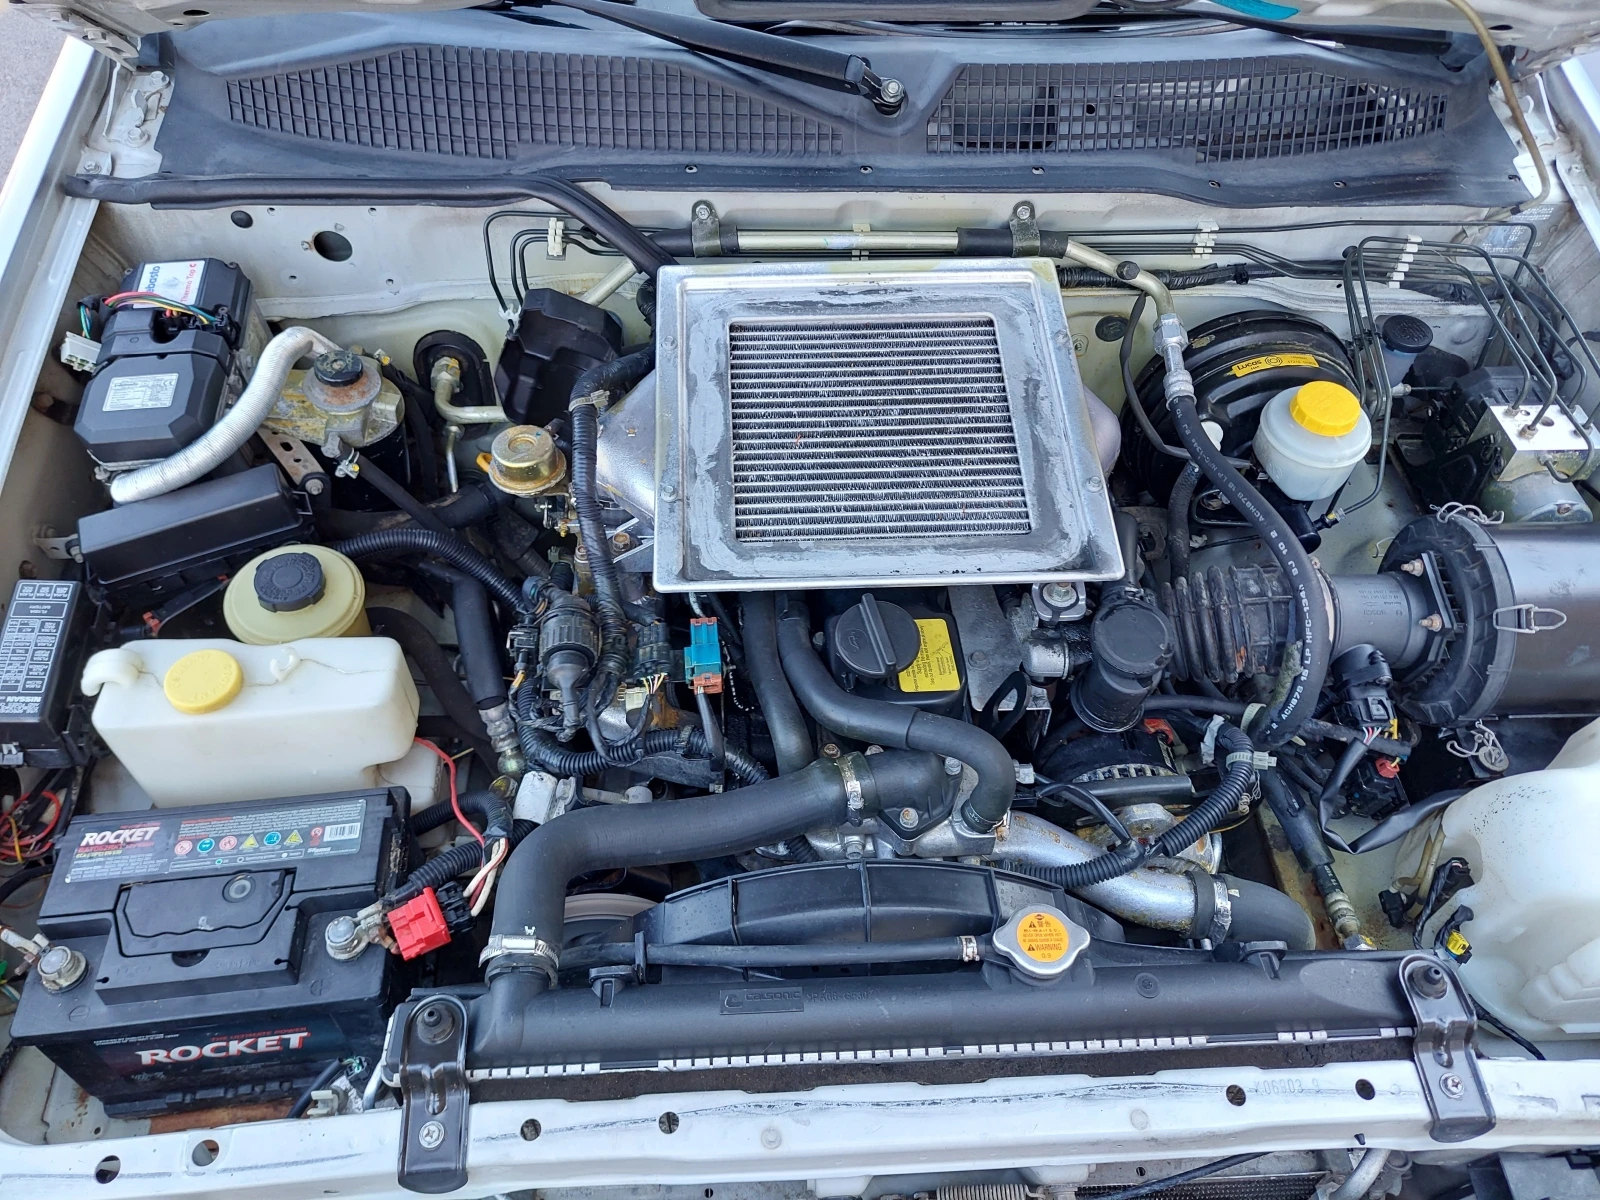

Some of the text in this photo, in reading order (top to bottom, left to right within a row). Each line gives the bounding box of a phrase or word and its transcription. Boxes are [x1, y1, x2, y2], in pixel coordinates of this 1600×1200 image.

[145, 266, 160, 292] ebasto
[180, 280, 192, 302] Thermo
[187, 269, 196, 279] Top
[1237, 359, 1262, 370] Lucas
[1304, 648, 1312, 665] LP
[80, 826, 160, 847] ROCKET
[1035, 943, 1062, 951] WARNING
[230, 1030, 272, 1040] ULTIMATE
[134, 1032, 312, 1066] ROCKET
